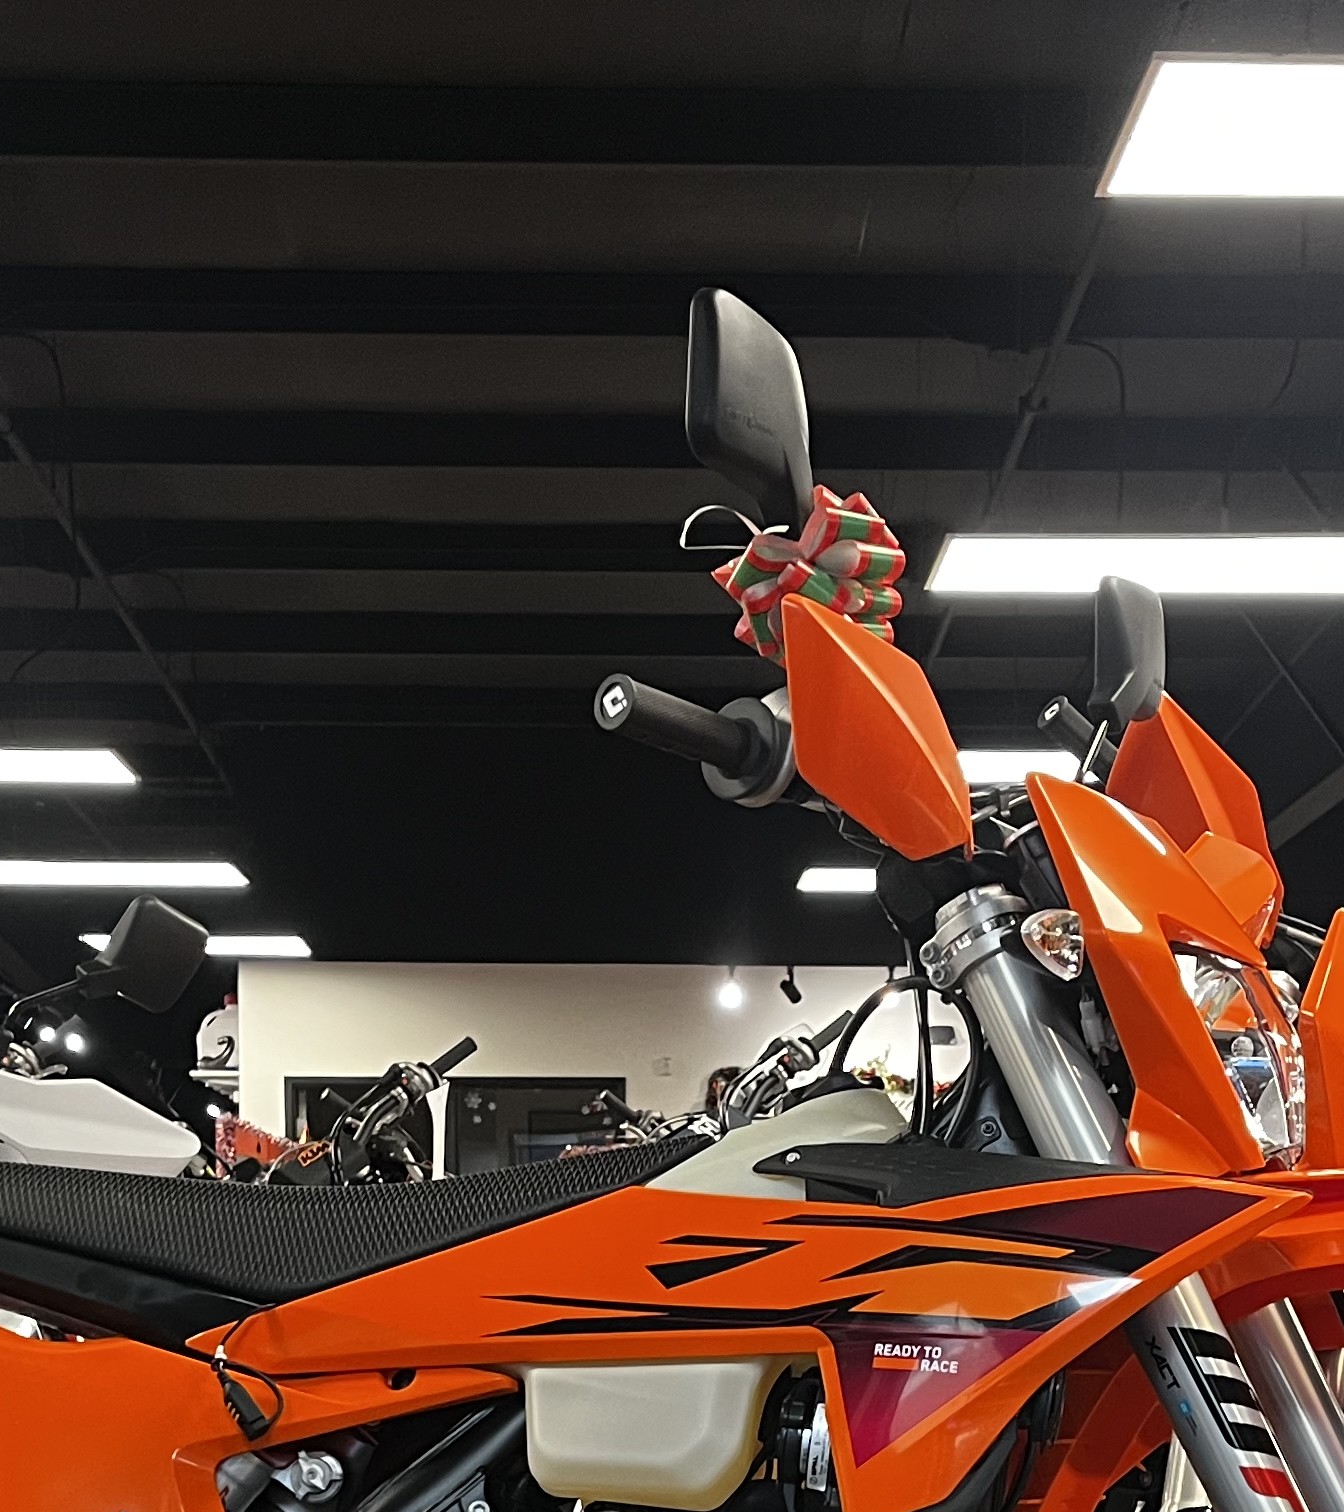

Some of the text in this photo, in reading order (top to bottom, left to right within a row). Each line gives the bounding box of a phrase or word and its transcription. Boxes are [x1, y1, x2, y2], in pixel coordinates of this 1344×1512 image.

[874, 1343, 942, 1359] READY TO
[920, 1359, 959, 1374] RACE
[1144, 1335, 1181, 1390] XACT
